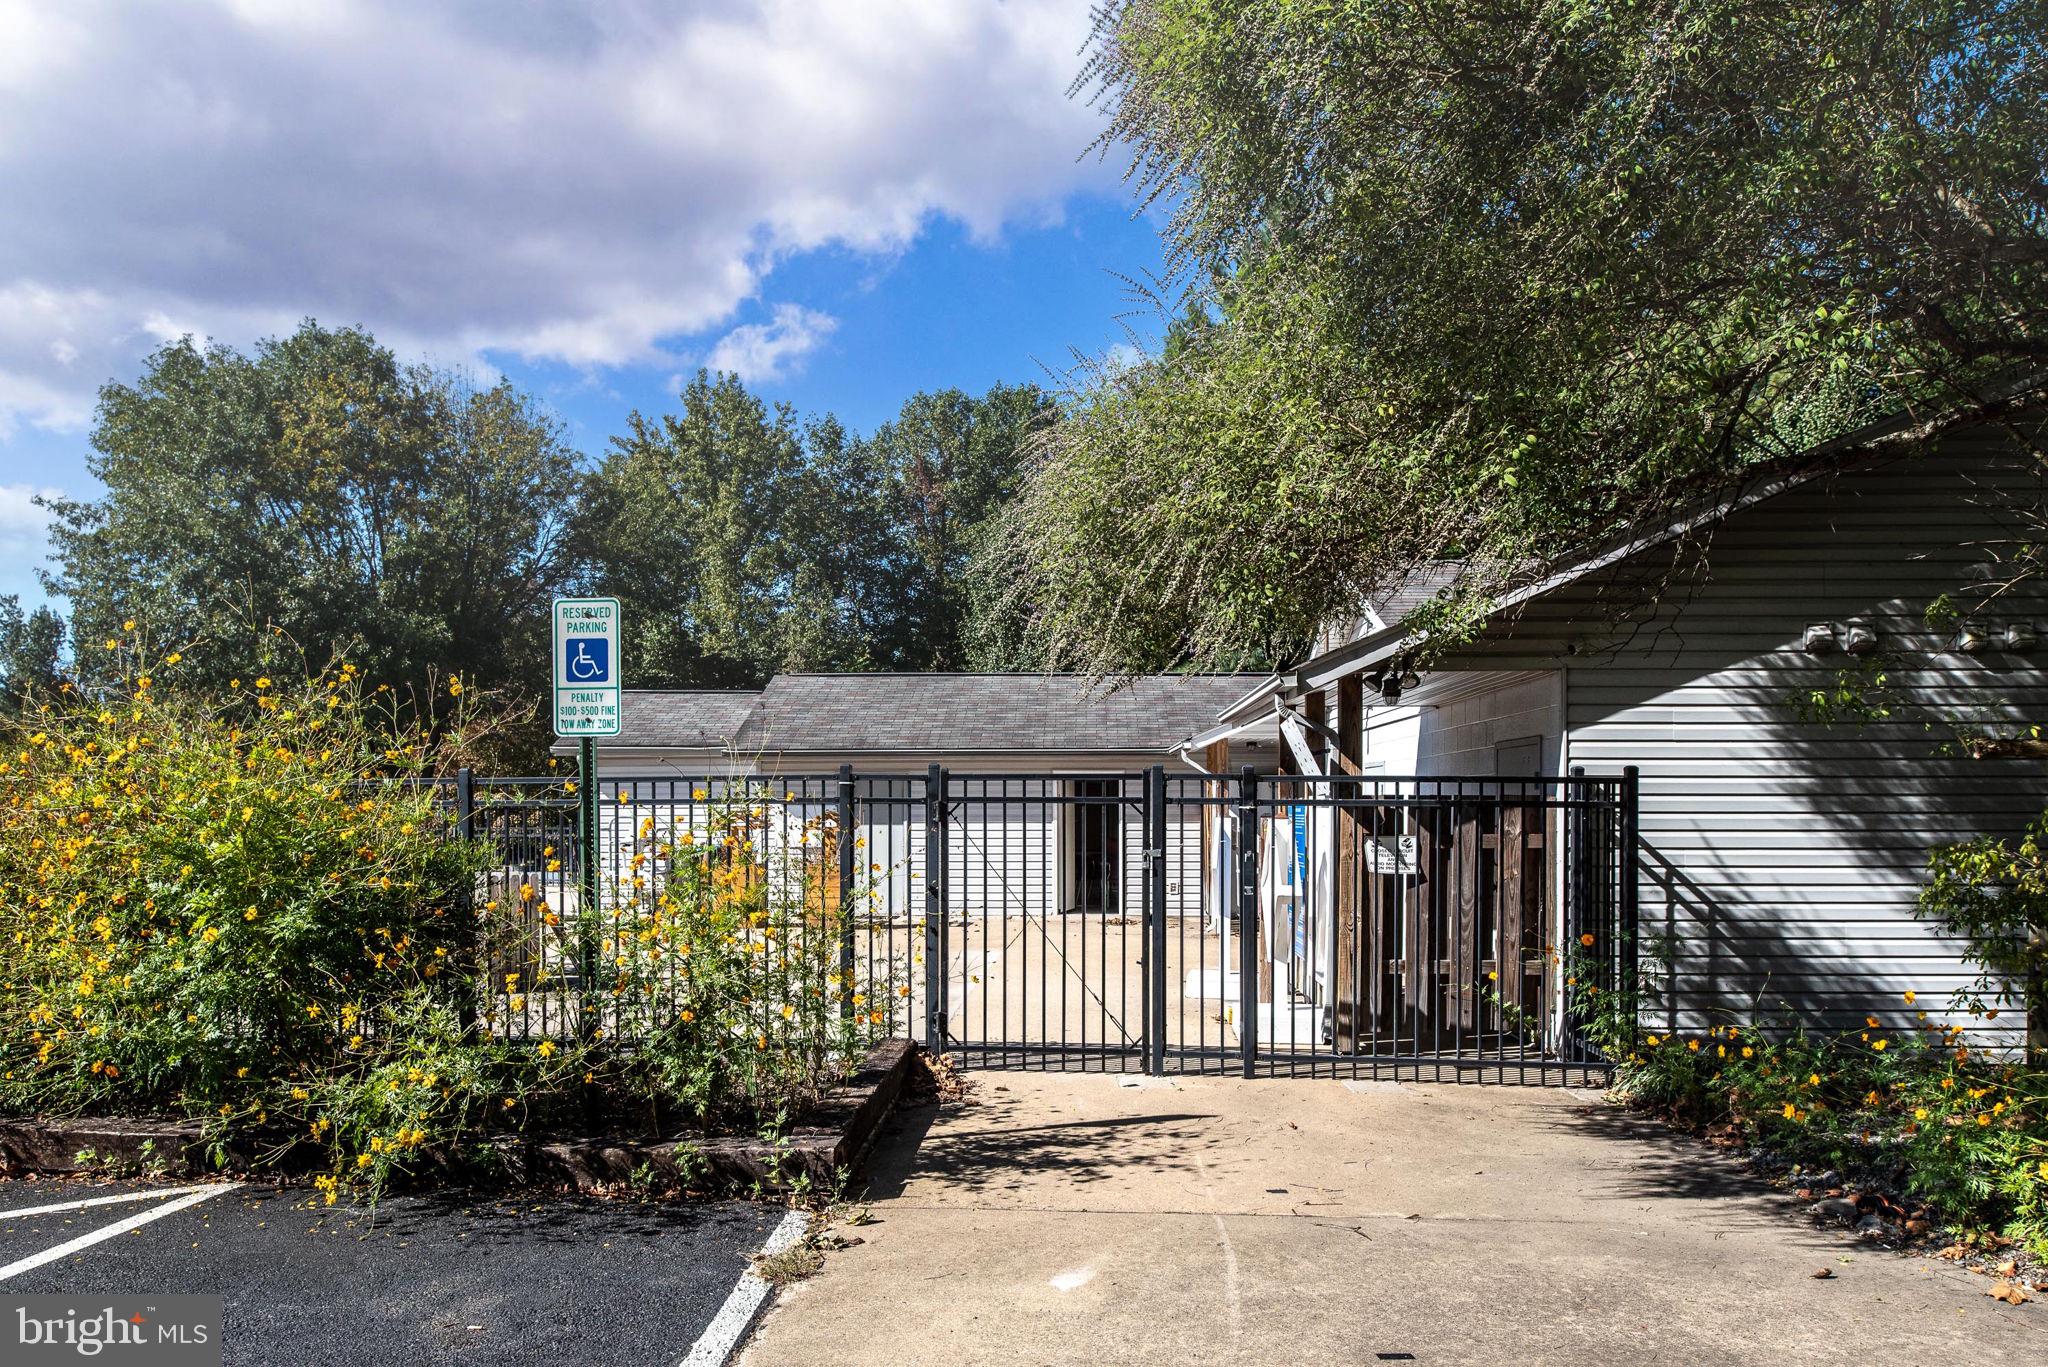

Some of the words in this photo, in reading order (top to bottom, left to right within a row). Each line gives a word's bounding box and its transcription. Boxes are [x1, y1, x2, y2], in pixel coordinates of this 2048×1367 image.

[562, 607, 611, 619] RESERVED
[566, 622, 608, 633] PARKING
[571, 692, 604, 703] PENALTY
[601, 705, 616, 716] FINE
[560, 719, 575, 729] TOW
[576, 719, 595, 729] AWAY
[597, 719, 616, 729] ZONE
